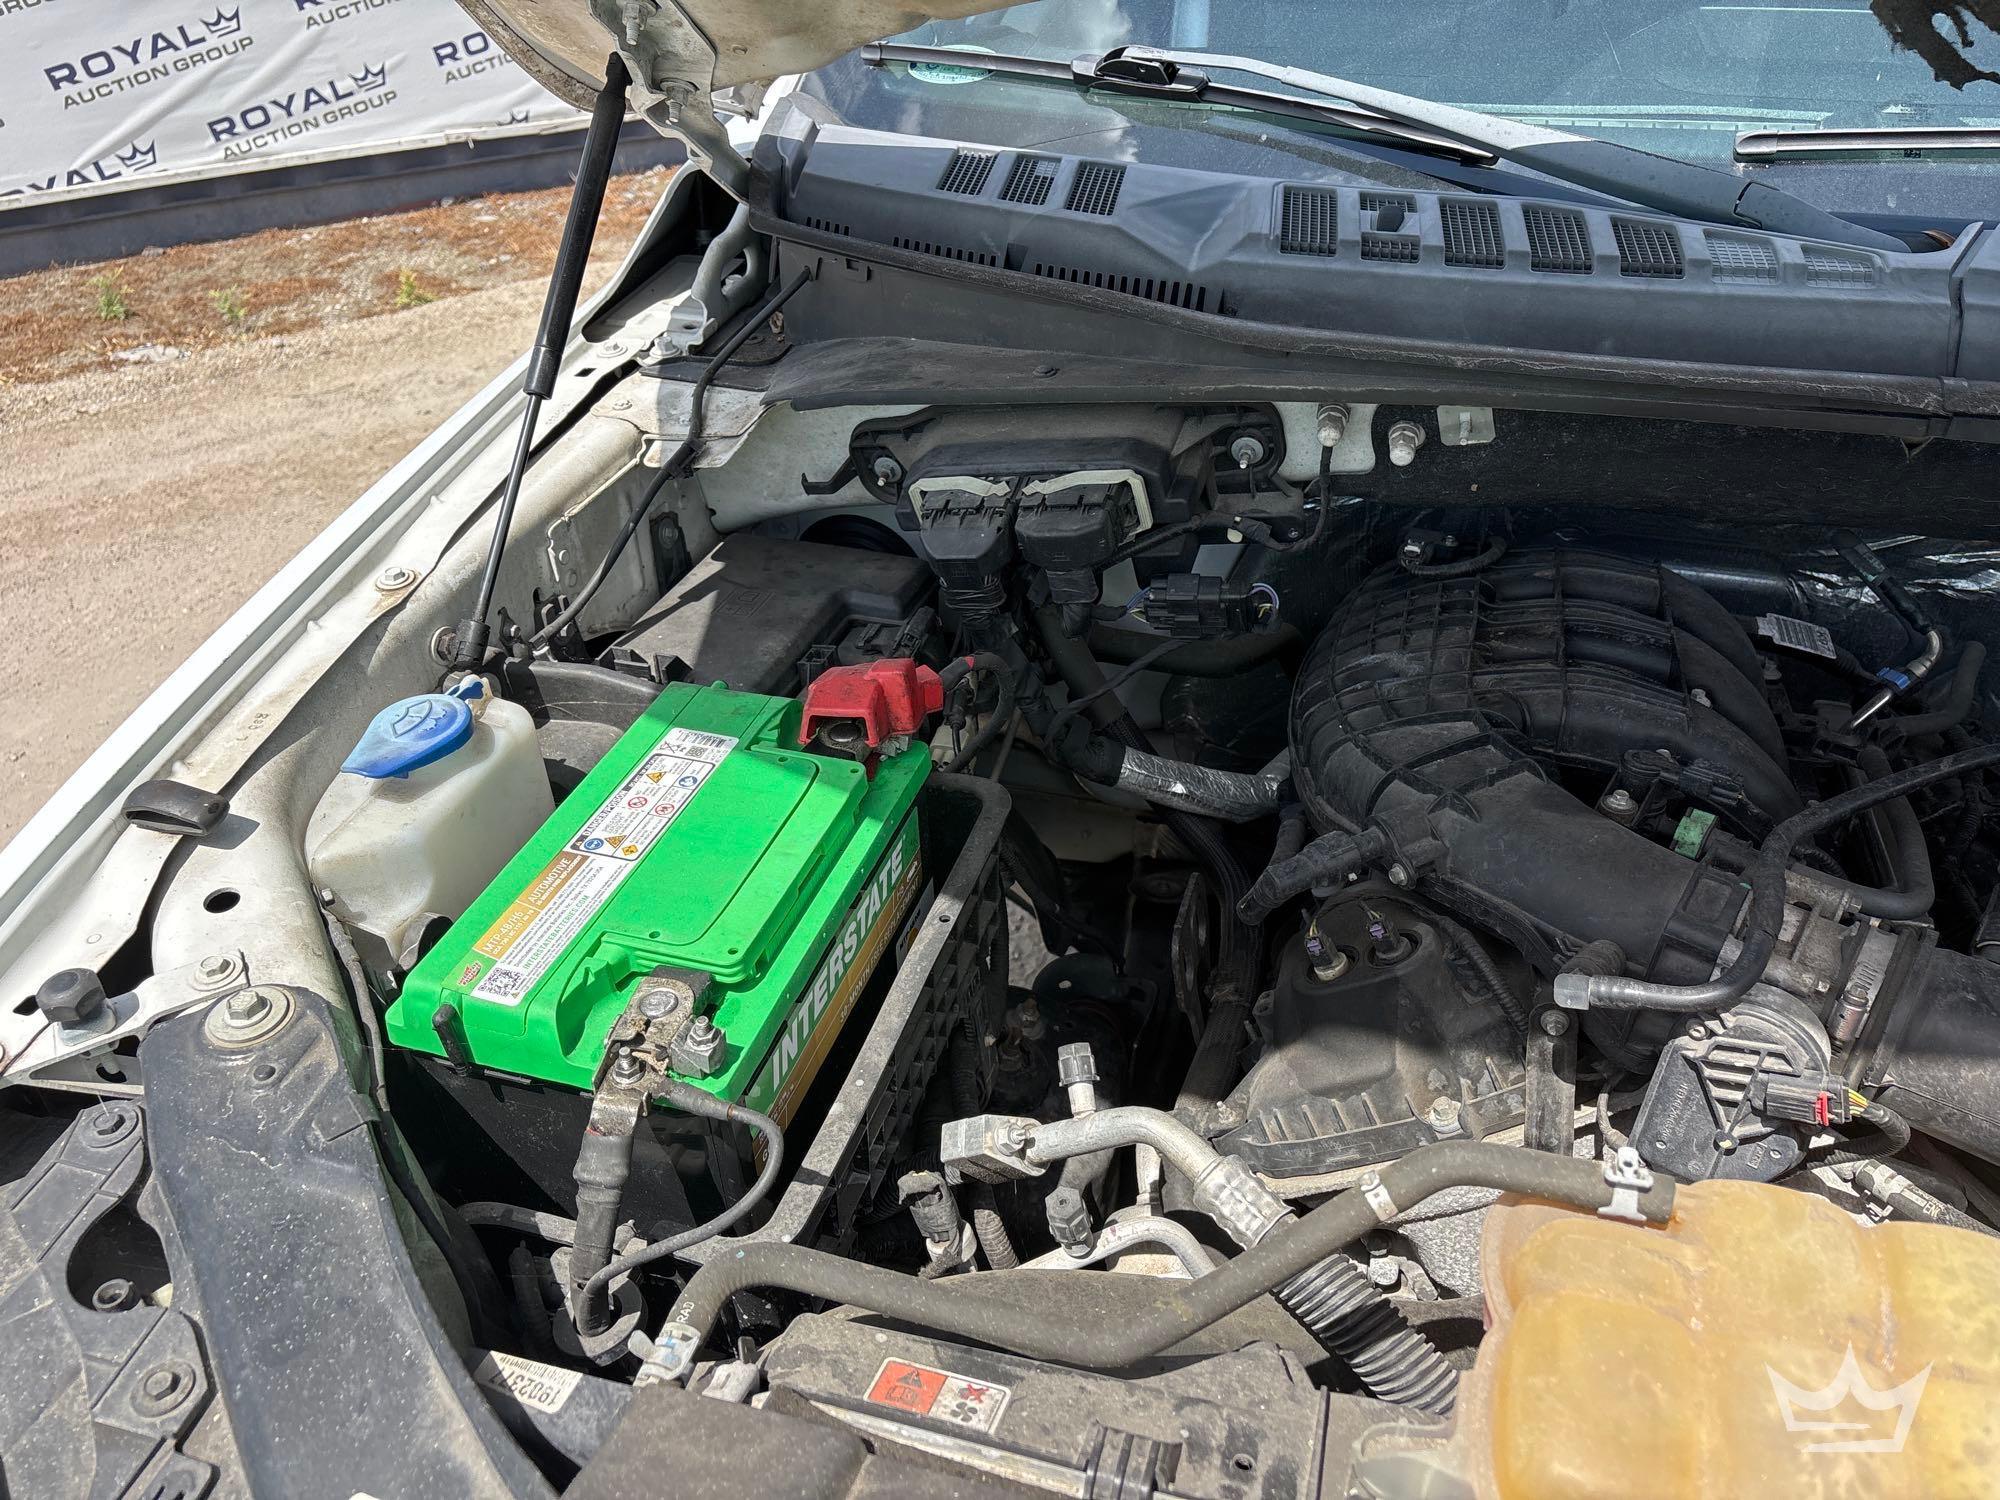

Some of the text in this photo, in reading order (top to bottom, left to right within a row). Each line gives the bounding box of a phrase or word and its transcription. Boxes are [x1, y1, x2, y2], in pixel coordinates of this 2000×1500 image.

[306, 0, 400, 30] AUCTIO
[44, 25, 207, 91] ROYAL
[64, 36, 254, 110] AUCTION GROUP
[207, 80, 354, 143] ROYAL
[223, 90, 397, 160] AUCTION GROUP
[527, 857, 571, 902] AUTOMOTIVE
[482, 909, 524, 951] MTP-48/H6
[773, 838, 903, 1092] INTERSTATE
